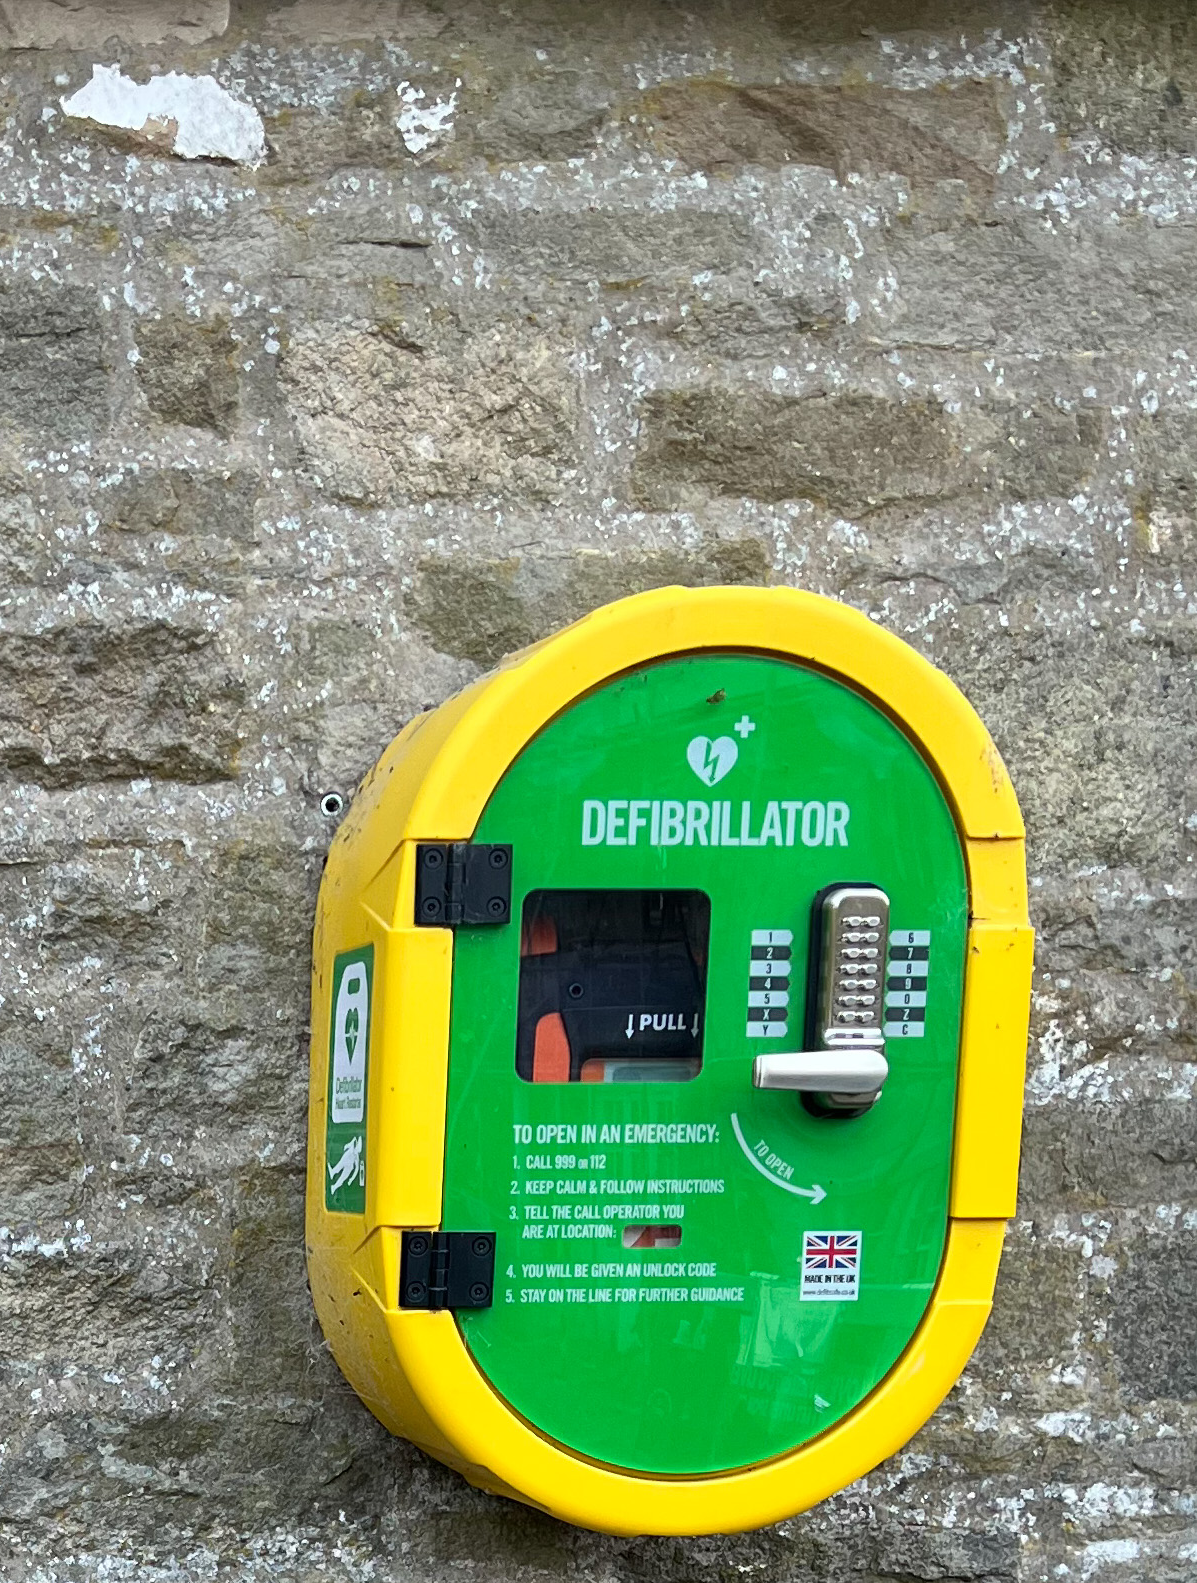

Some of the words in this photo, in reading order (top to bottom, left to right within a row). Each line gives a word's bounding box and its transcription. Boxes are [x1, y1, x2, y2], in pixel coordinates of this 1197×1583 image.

[581, 799, 851, 847] DEFIBRILLATOR
[768, 932, 773, 943] 1
[908, 932, 914, 943] 6
[766, 947, 773, 959] 2
[907, 947, 914, 959] 7
[765, 963, 772, 974] 3
[906, 963, 912, 974] 8
[764, 978, 771, 989] 4
[905, 978, 911, 989] 9
[764, 993, 770, 1004] 5
[762, 1009, 770, 1020] X
[903, 1009, 910, 1020] Z
[639, 1013, 686, 1031] PULL
[762, 1024, 769, 1035] Y
[902, 1024, 908, 1035] C
[513, 1124, 532, 1144] TO
[536, 1124, 577, 1144] OPEN
[581, 1124, 597, 1144] IN
[600, 1124, 621, 1143] AN
[624, 1123, 720, 1143] EMERGENCY:
[513, 1155, 521, 1170] 1.
[525, 1155, 552, 1169] CALL
[555, 1155, 576, 1169] 999
[590, 1154, 606, 1169] 112
[754, 1139, 770, 1157] TO
[764, 1153, 794, 1180] OPEN
[510, 1180, 520, 1195] 2.
[525, 1180, 554, 1194] KEEP
[556, 1180, 587, 1194] CALM
[589, 1180, 597, 1194] &
[600, 1180, 645, 1194] FOLLOW
[647, 1179, 724, 1194] INSTRUCTIONS
[509, 1206, 519, 1220] 3.
[524, 1205, 549, 1219] TELL
[551, 1205, 572, 1219] THE
[574, 1205, 601, 1219] CALL
[603, 1205, 660, 1219] OPERATOR
[662, 1205, 685, 1219] YOU
[522, 1225, 544, 1239] ARE
[546, 1225, 559, 1239] AT
[561, 1225, 617, 1239] LOCATION:
[506, 1265, 516, 1278] 4.
[522, 1264, 544, 1278] YOU
[546, 1264, 572, 1278] WILL
[574, 1264, 588, 1277] BE
[591, 1264, 624, 1277] GIVEN
[625, 1264, 641, 1277] AN
[643, 1263, 685, 1277] UNLOCK
[688, 1263, 716, 1277] CODE
[804, 1274, 823, 1284] MADE
[824, 1274, 832, 1284] IN
[833, 1274, 845, 1284] THE
[846, 1274, 856, 1284] UK
[505, 1289, 515, 1303] 5.
[520, 1289, 546, 1303] STAY
[549, 1289, 563, 1303] ON
[566, 1289, 587, 1302] THE
[589, 1289, 612, 1302] LINE
[614, 1288, 636, 1302] FOR
[638, 1288, 688, 1302] FURTHER
[690, 1287, 744, 1302] GUIDANCE
